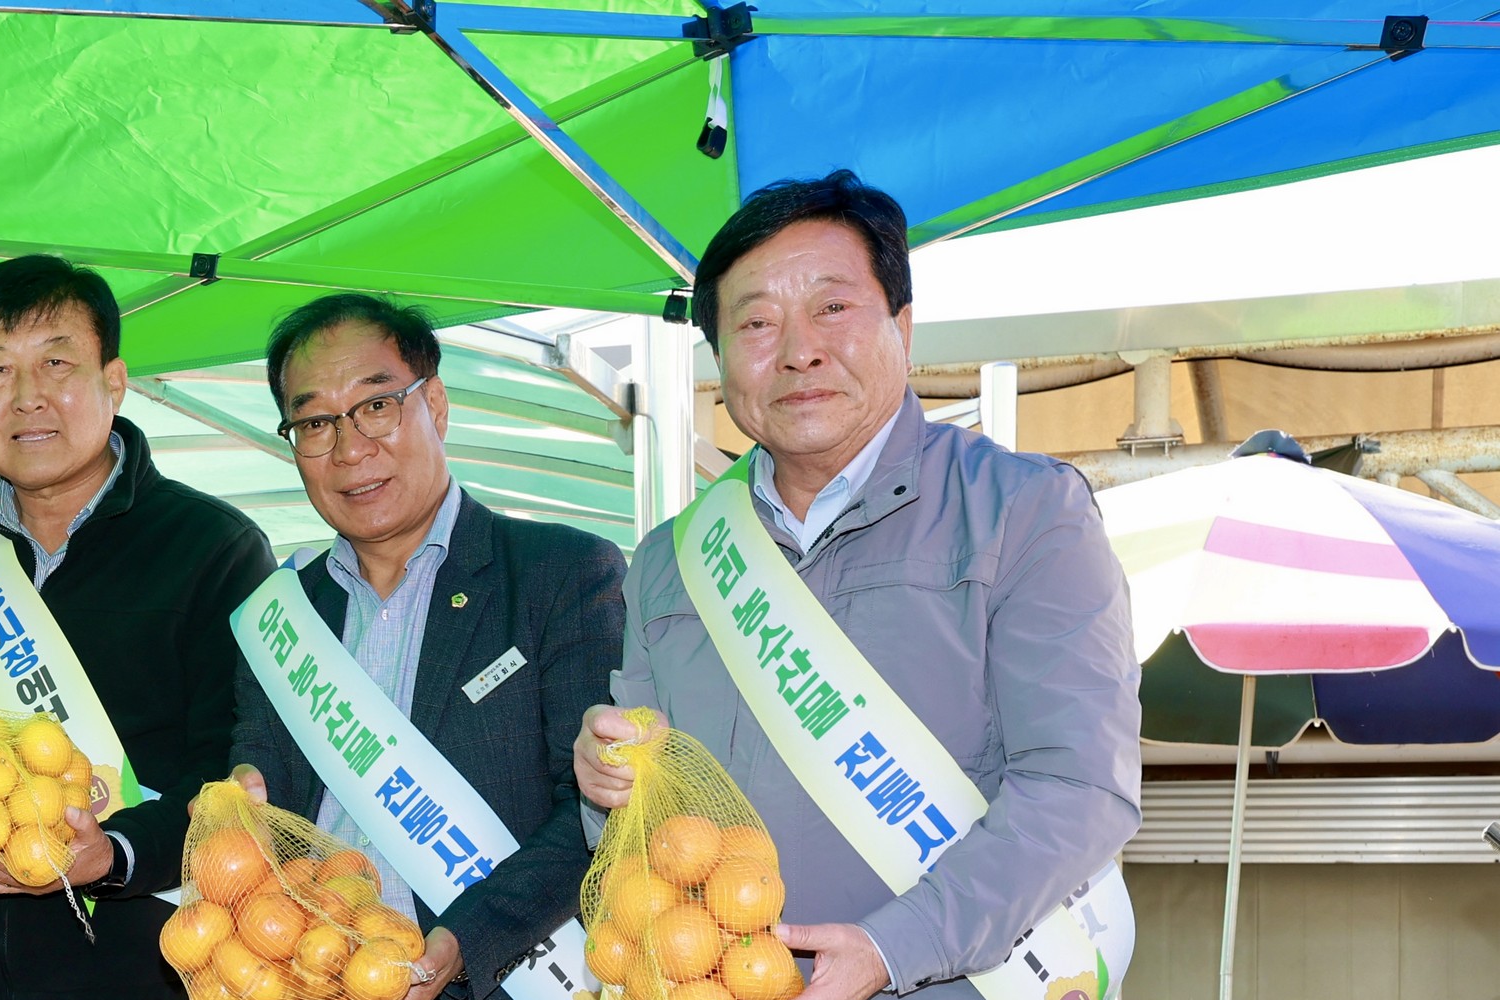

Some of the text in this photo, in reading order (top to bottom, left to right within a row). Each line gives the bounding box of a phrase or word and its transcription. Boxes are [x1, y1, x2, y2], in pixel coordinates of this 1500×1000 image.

[258, 598, 299, 668] 우리
[288, 653, 397, 778] 농수산물,
[700, 516, 962, 873] 우리 농수산물, 전통시
[90, 780, 108, 804] 회
